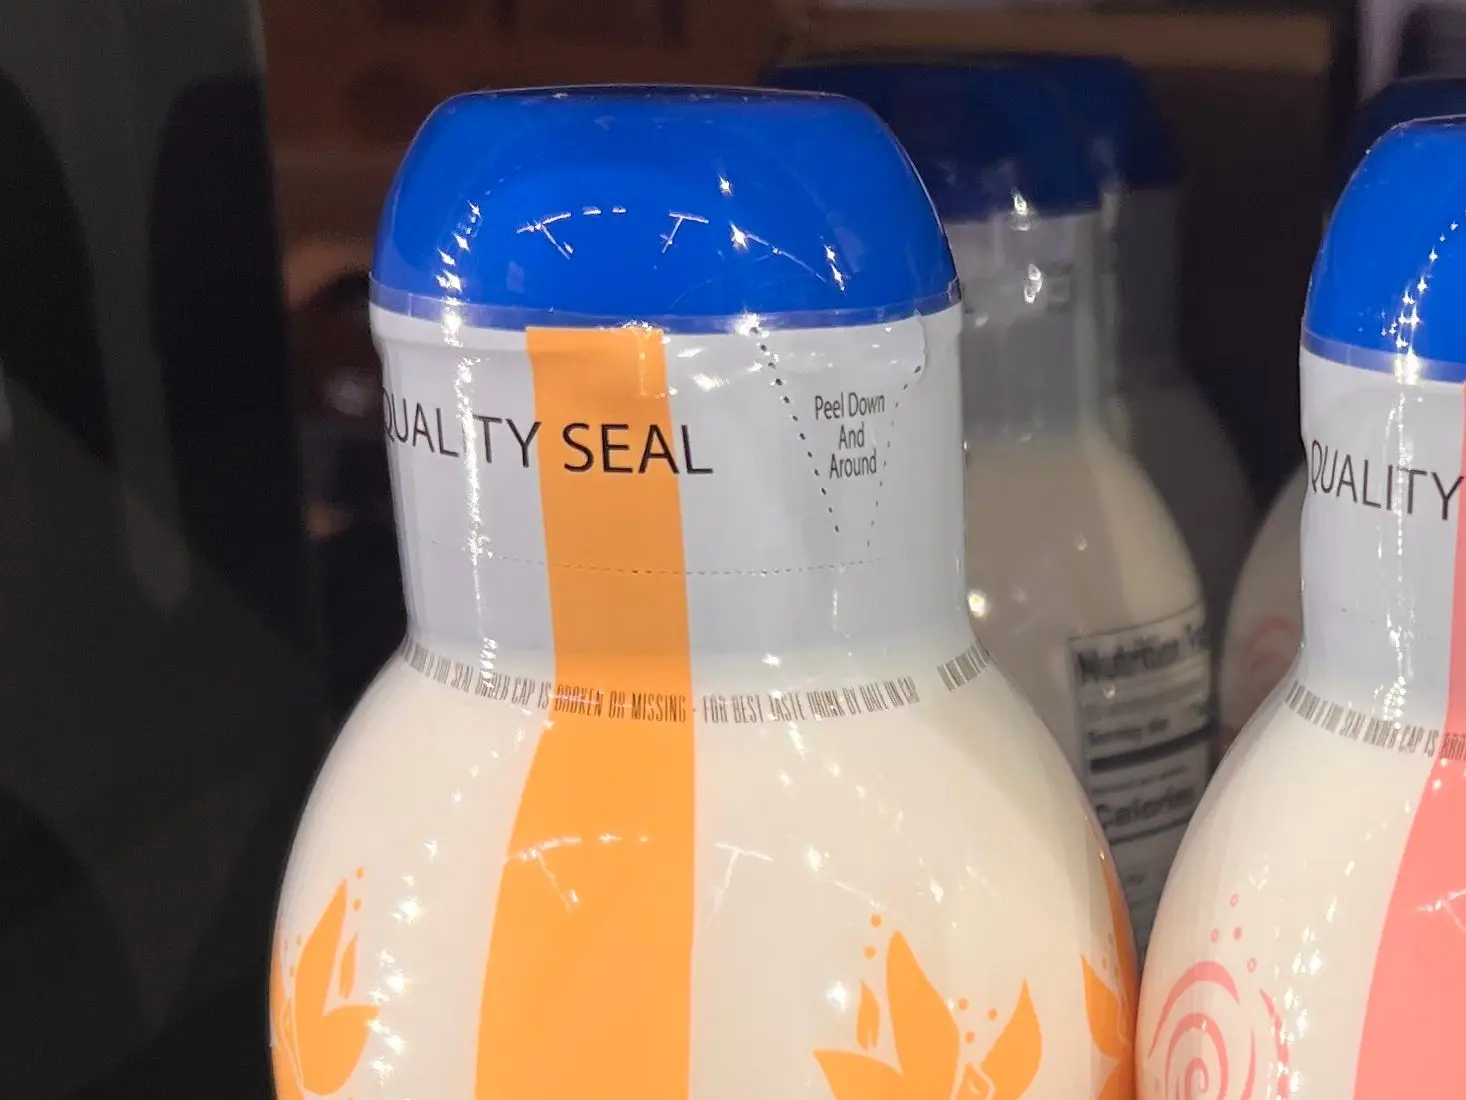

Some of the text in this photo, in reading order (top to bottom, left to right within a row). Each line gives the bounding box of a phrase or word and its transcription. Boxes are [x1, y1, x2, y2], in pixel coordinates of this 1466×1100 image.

[814, 391, 885, 420] Peel Down
[382, 386, 713, 474] QUALTY SEAL
[838, 421, 865, 450] And
[829, 447, 877, 479] Around
[1311, 440, 1464, 521] QUALITY
[536, 681, 552, 709] IS
[553, 683, 603, 717] BROKEN
[608, 689, 625, 720] OR
[630, 691, 687, 723] MISSING
[703, 695, 728, 723] FOR
[732, 694, 764, 723] BEST
[767, 691, 806, 722] TASTE
